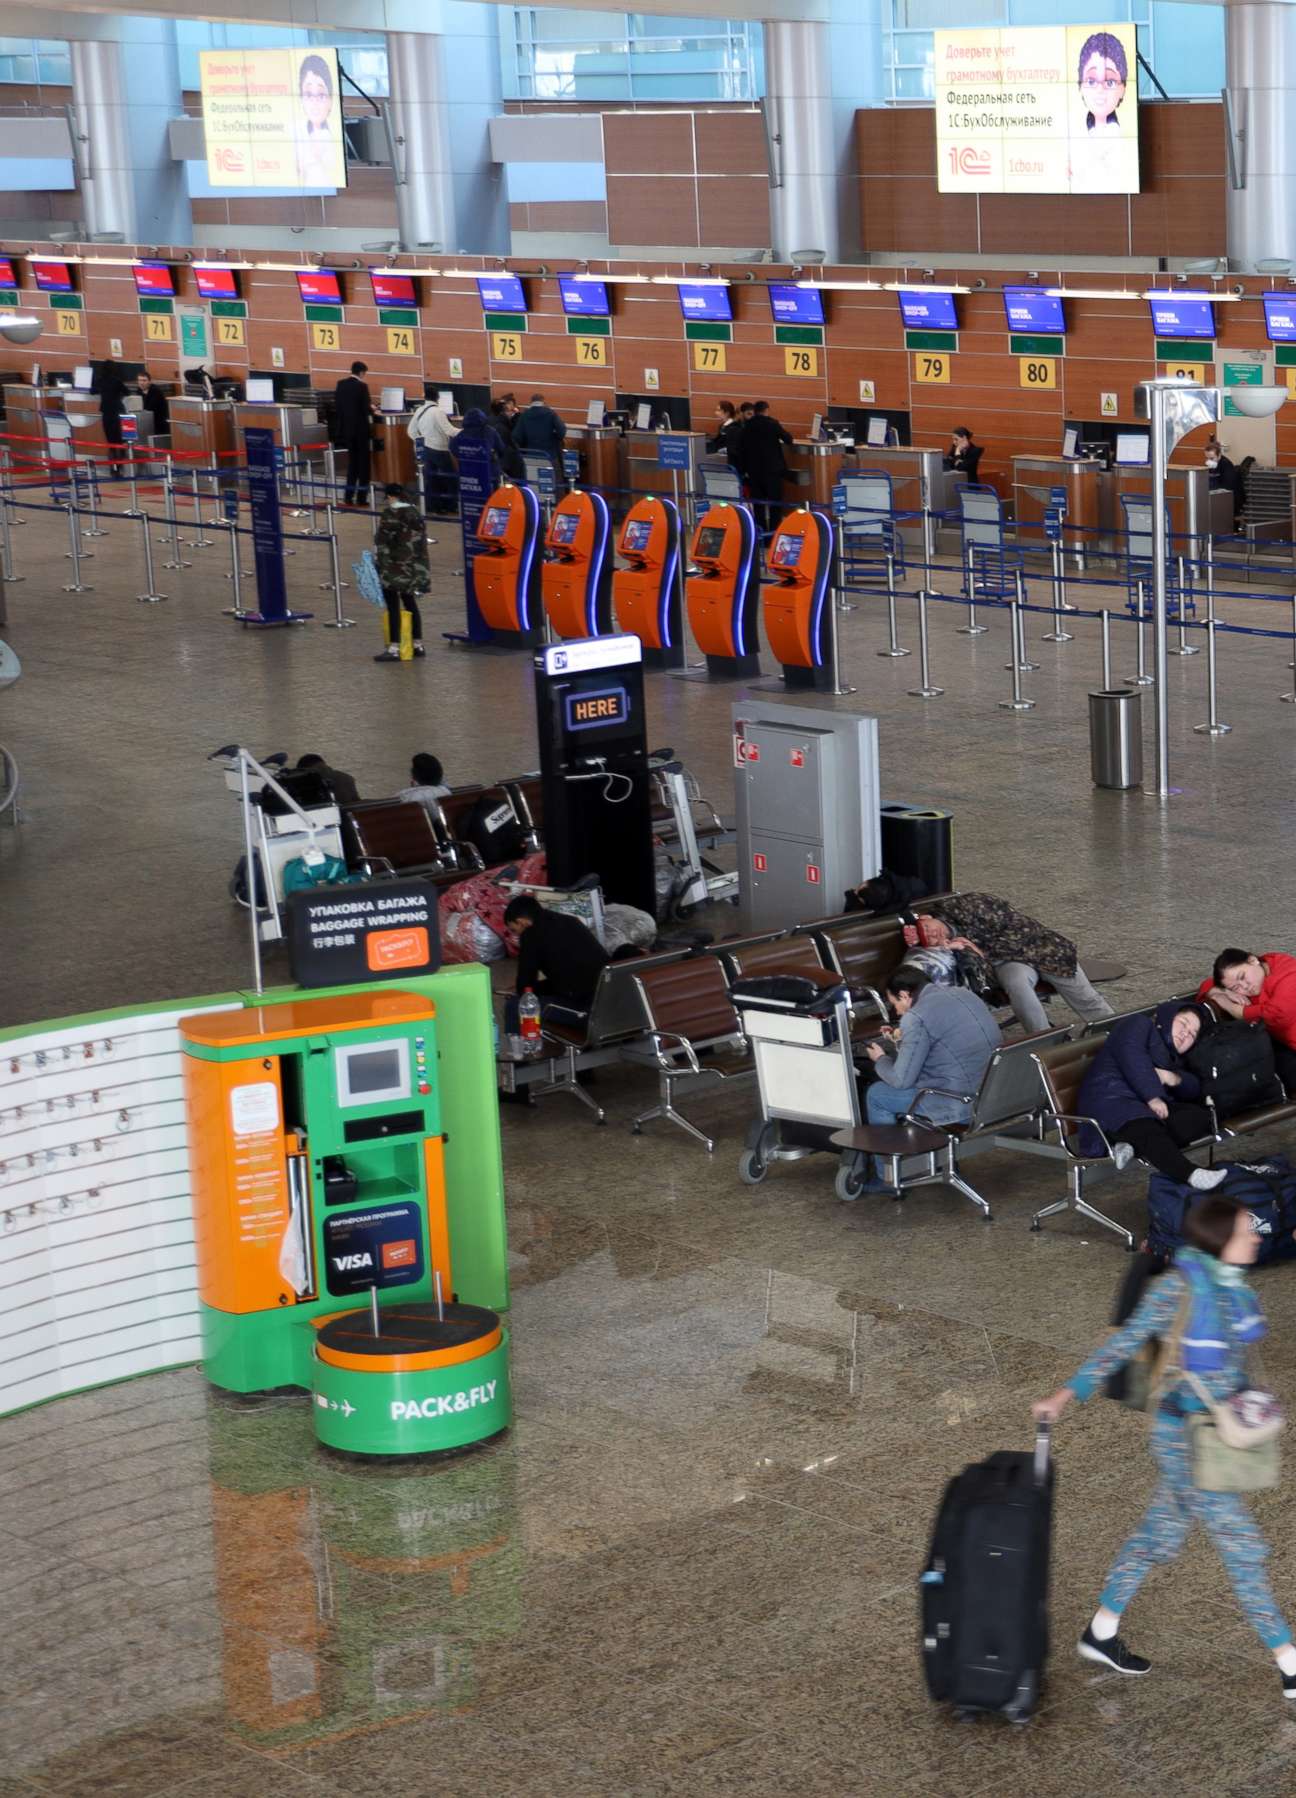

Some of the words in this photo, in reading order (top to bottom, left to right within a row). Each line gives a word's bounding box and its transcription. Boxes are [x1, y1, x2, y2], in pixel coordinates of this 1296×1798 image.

[947, 91, 1013, 107] Федеральная
[1016, 91, 1036, 104] сеть
[152, 320, 166, 336] 71
[224, 324, 238, 339] 72
[319, 329, 334, 345] 73
[393, 333, 409, 349] 74
[500, 338, 516, 356] 75
[582, 342, 600, 360] 76
[701, 348, 719, 366] 77
[791, 352, 810, 371] 78
[923, 358, 943, 378] 79
[1027, 363, 1048, 383] 80
[576, 698, 617, 720] HERE
[309, 901, 375, 917] УПАКОВКА
[377, 896, 427, 910] БАГАЖА
[310, 918, 365, 933] BAGGAGE
[367, 911, 428, 926] WRAPPING
[332, 1252, 373, 1271] VISA
[390, 1379, 497, 1420] PACK&FLY
